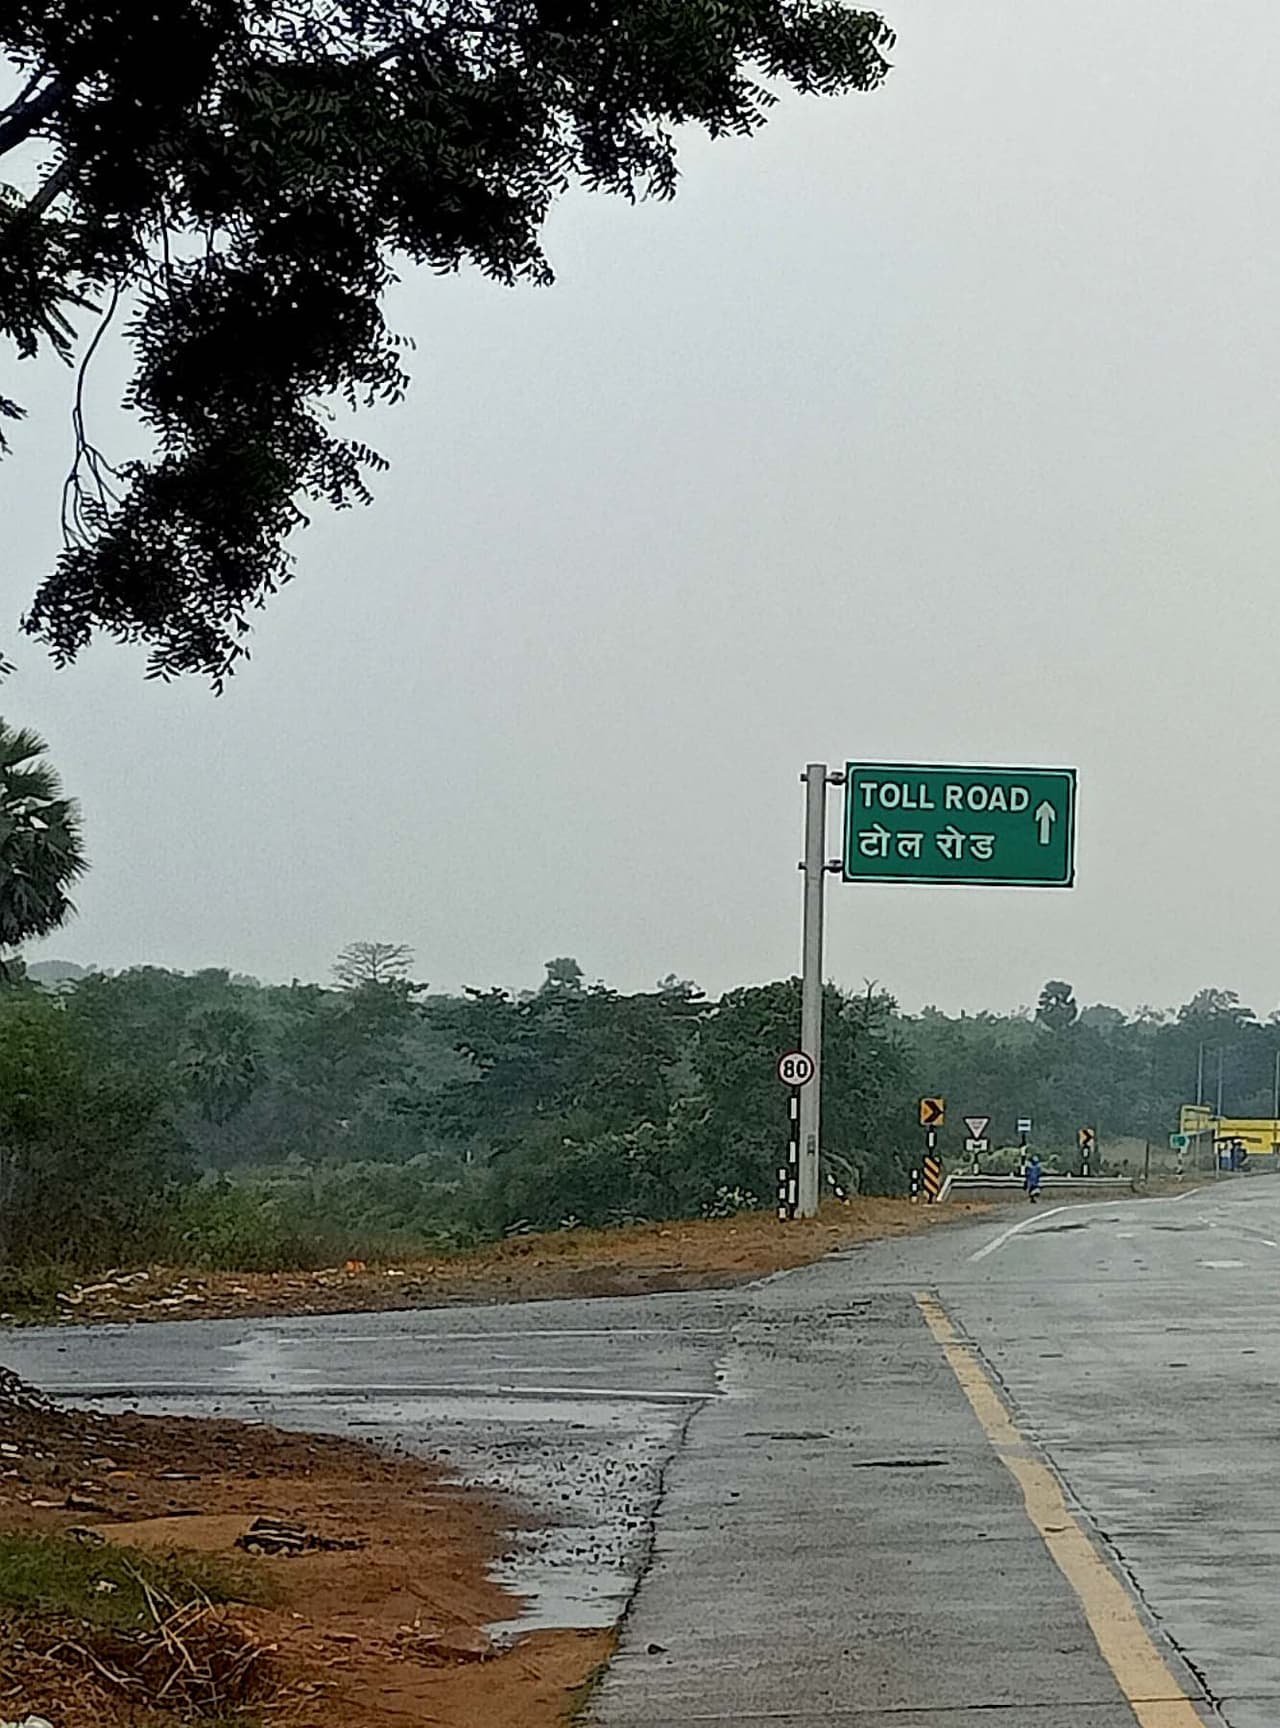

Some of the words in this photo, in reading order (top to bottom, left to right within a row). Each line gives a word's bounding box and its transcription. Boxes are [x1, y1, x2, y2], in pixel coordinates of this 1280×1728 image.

[860, 782, 935, 810] TOLL
[945, 785, 1030, 812] ROAD
[936, 825, 995, 860] रोड
[784, 1060, 808, 1078] 80
